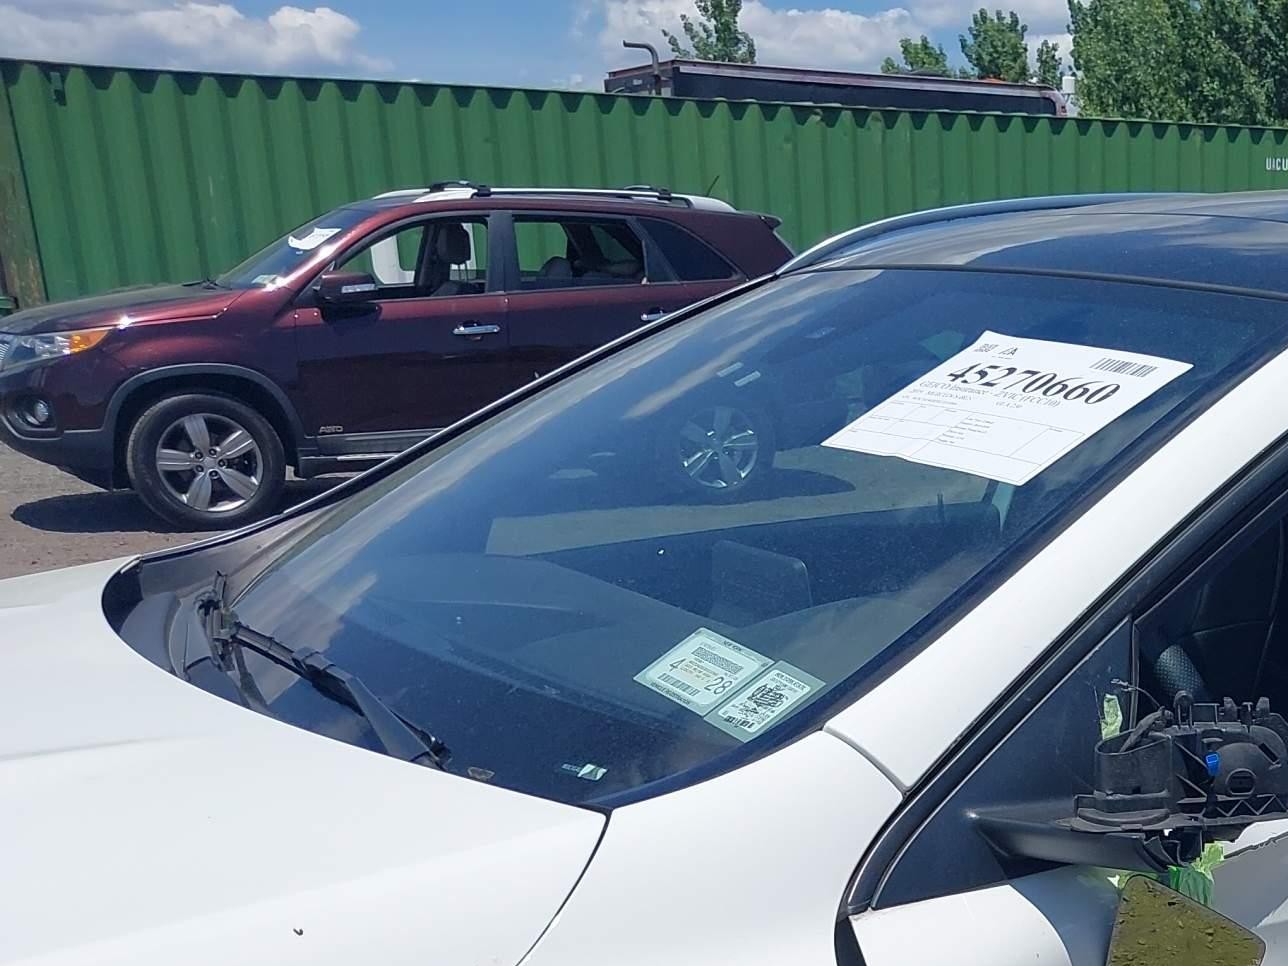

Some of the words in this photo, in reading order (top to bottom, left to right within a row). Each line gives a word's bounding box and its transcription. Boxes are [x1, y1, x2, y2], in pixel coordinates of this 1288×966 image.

[947, 363, 1120, 405] 45270660
[668, 657, 686, 673] 4
[703, 676, 733, 695] 28
